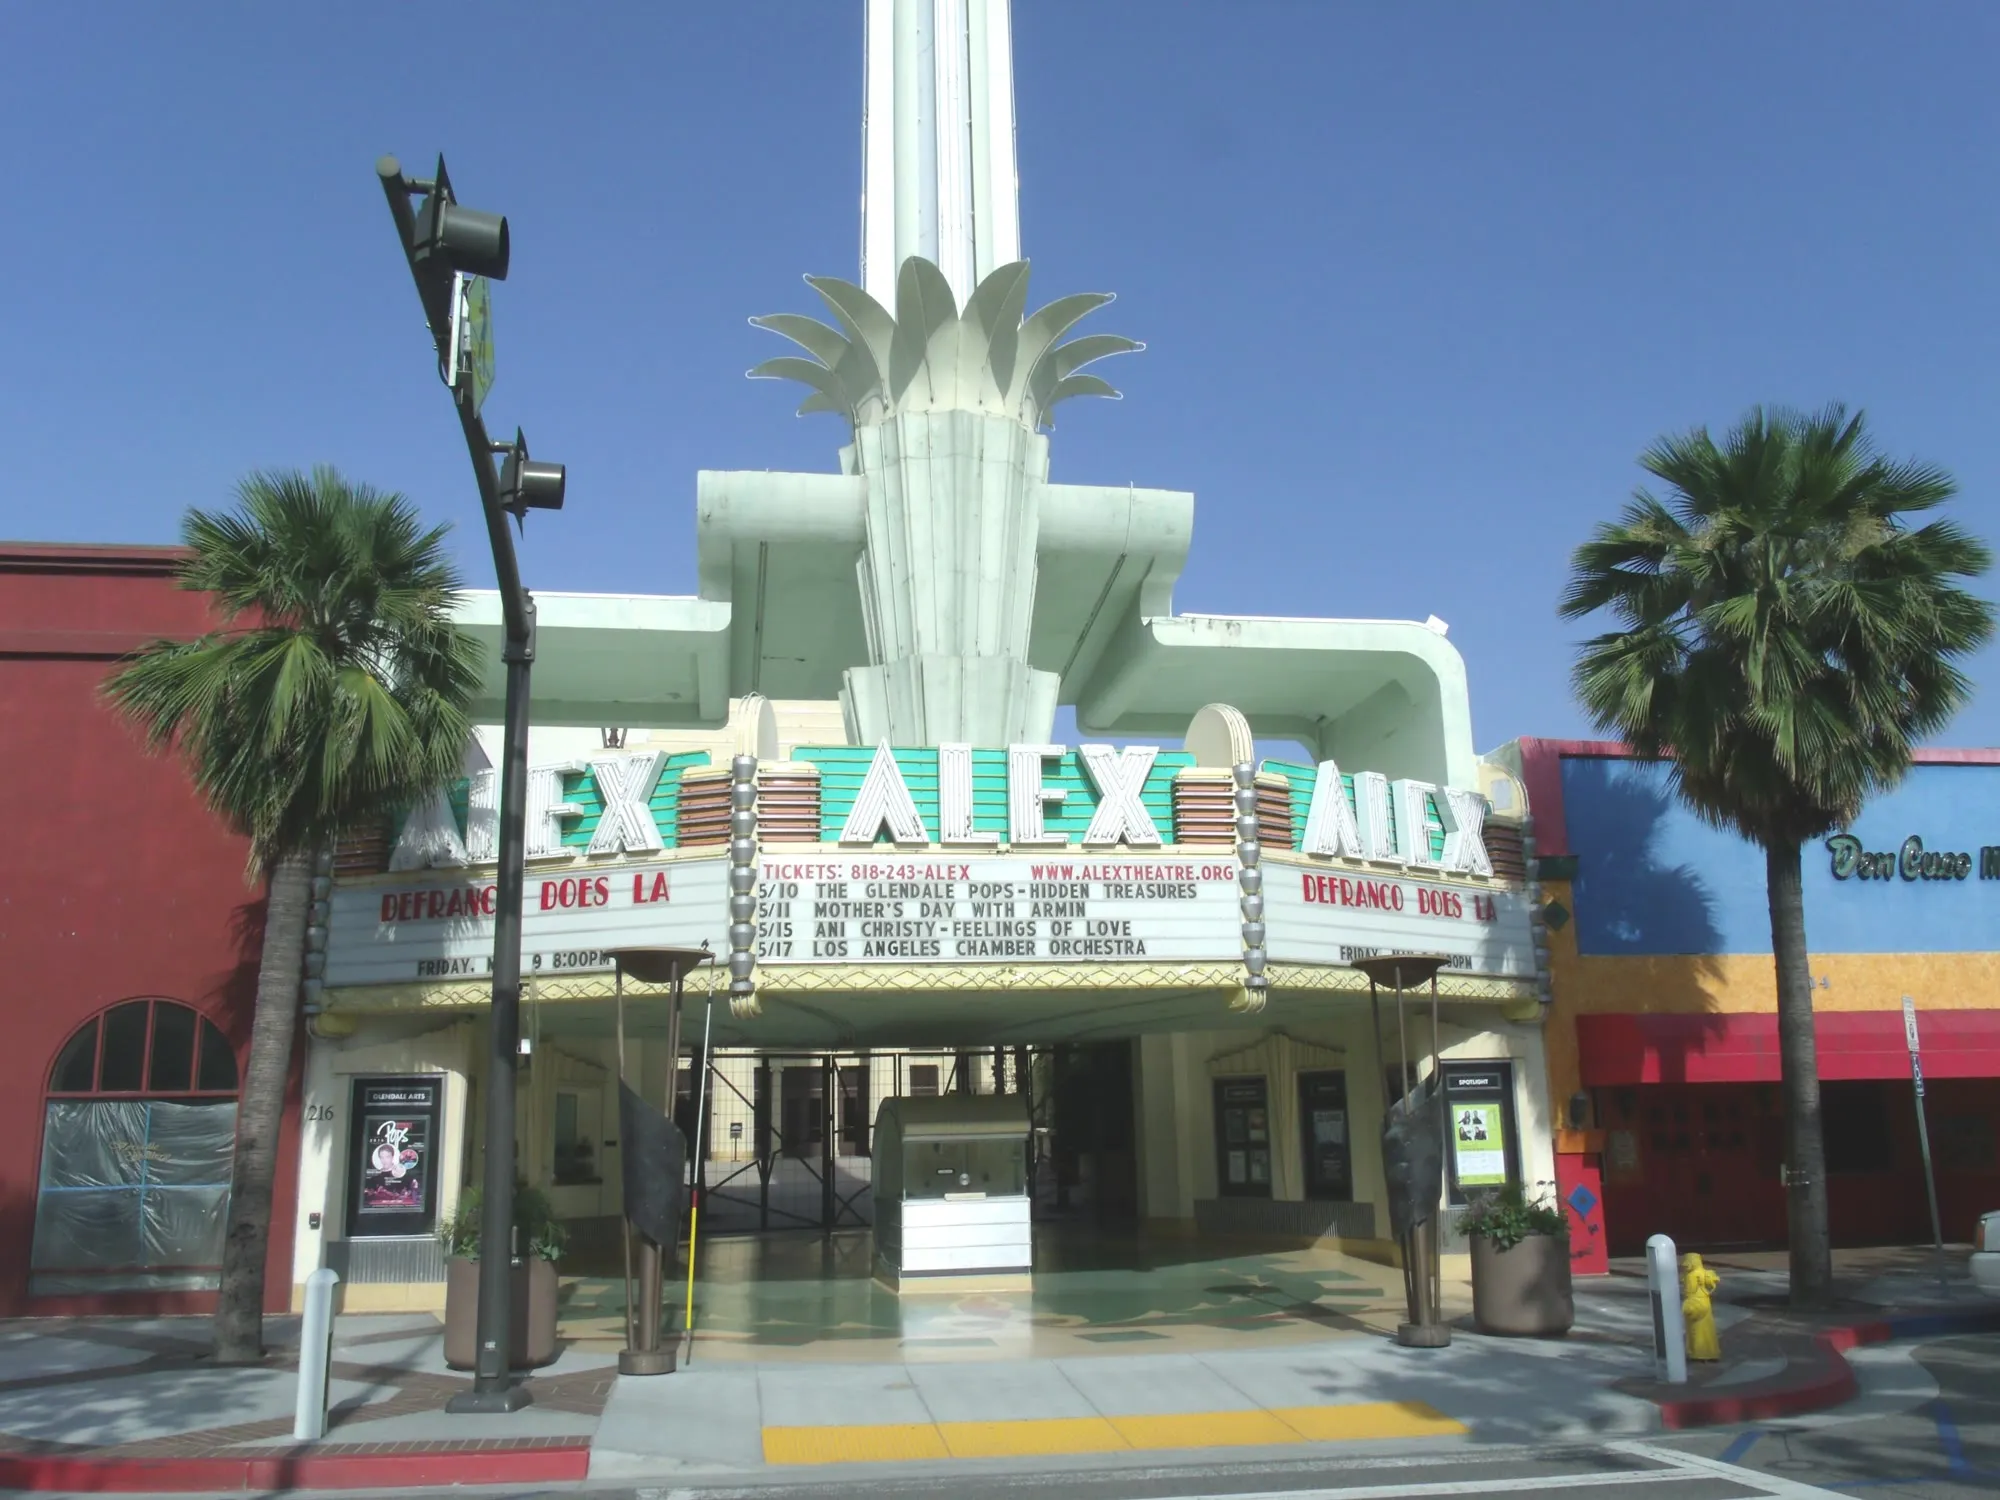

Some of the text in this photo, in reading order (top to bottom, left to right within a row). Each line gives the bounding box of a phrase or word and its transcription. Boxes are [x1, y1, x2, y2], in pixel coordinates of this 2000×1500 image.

[838, 736, 1162, 844] ALEX
[1301, 760, 1494, 877] ALEX
[1825, 834, 1896, 882] Don
[763, 863, 1234, 881] TICKETS: 818-243-ALEX WWW.ALEXTHEATRE.ORG
[380, 872, 670, 922] DEFRANC DOES LA
[759, 883, 799, 899] 5/10
[816, 883, 848, 899] THE
[865, 883, 954, 899] GLENDALE
[1103, 883, 1197, 899] TREASURES
[1302, 874, 1497, 922] DEFRANCO DOES LA
[759, 902, 1086, 918] 5/11 MOTHER'S DAY WITH ARMIN
[759, 922, 793, 938] 5/15
[815, 922, 845, 937] ANI
[1051, 921, 1073, 937] OF
[1087, 921, 1132, 937] LOVE
[758, 940, 1146, 957] 5/17 LOS ANGELES CHAMBER ORCHESTRA
[532, 954, 542, 969] 9
[552, 951, 611, 969] 8:00PM
[1458, 1078, 1489, 1086] SPOTLIGHT
[308, 1105, 334, 1121] 216
[377, 1120, 409, 1150] Pops
